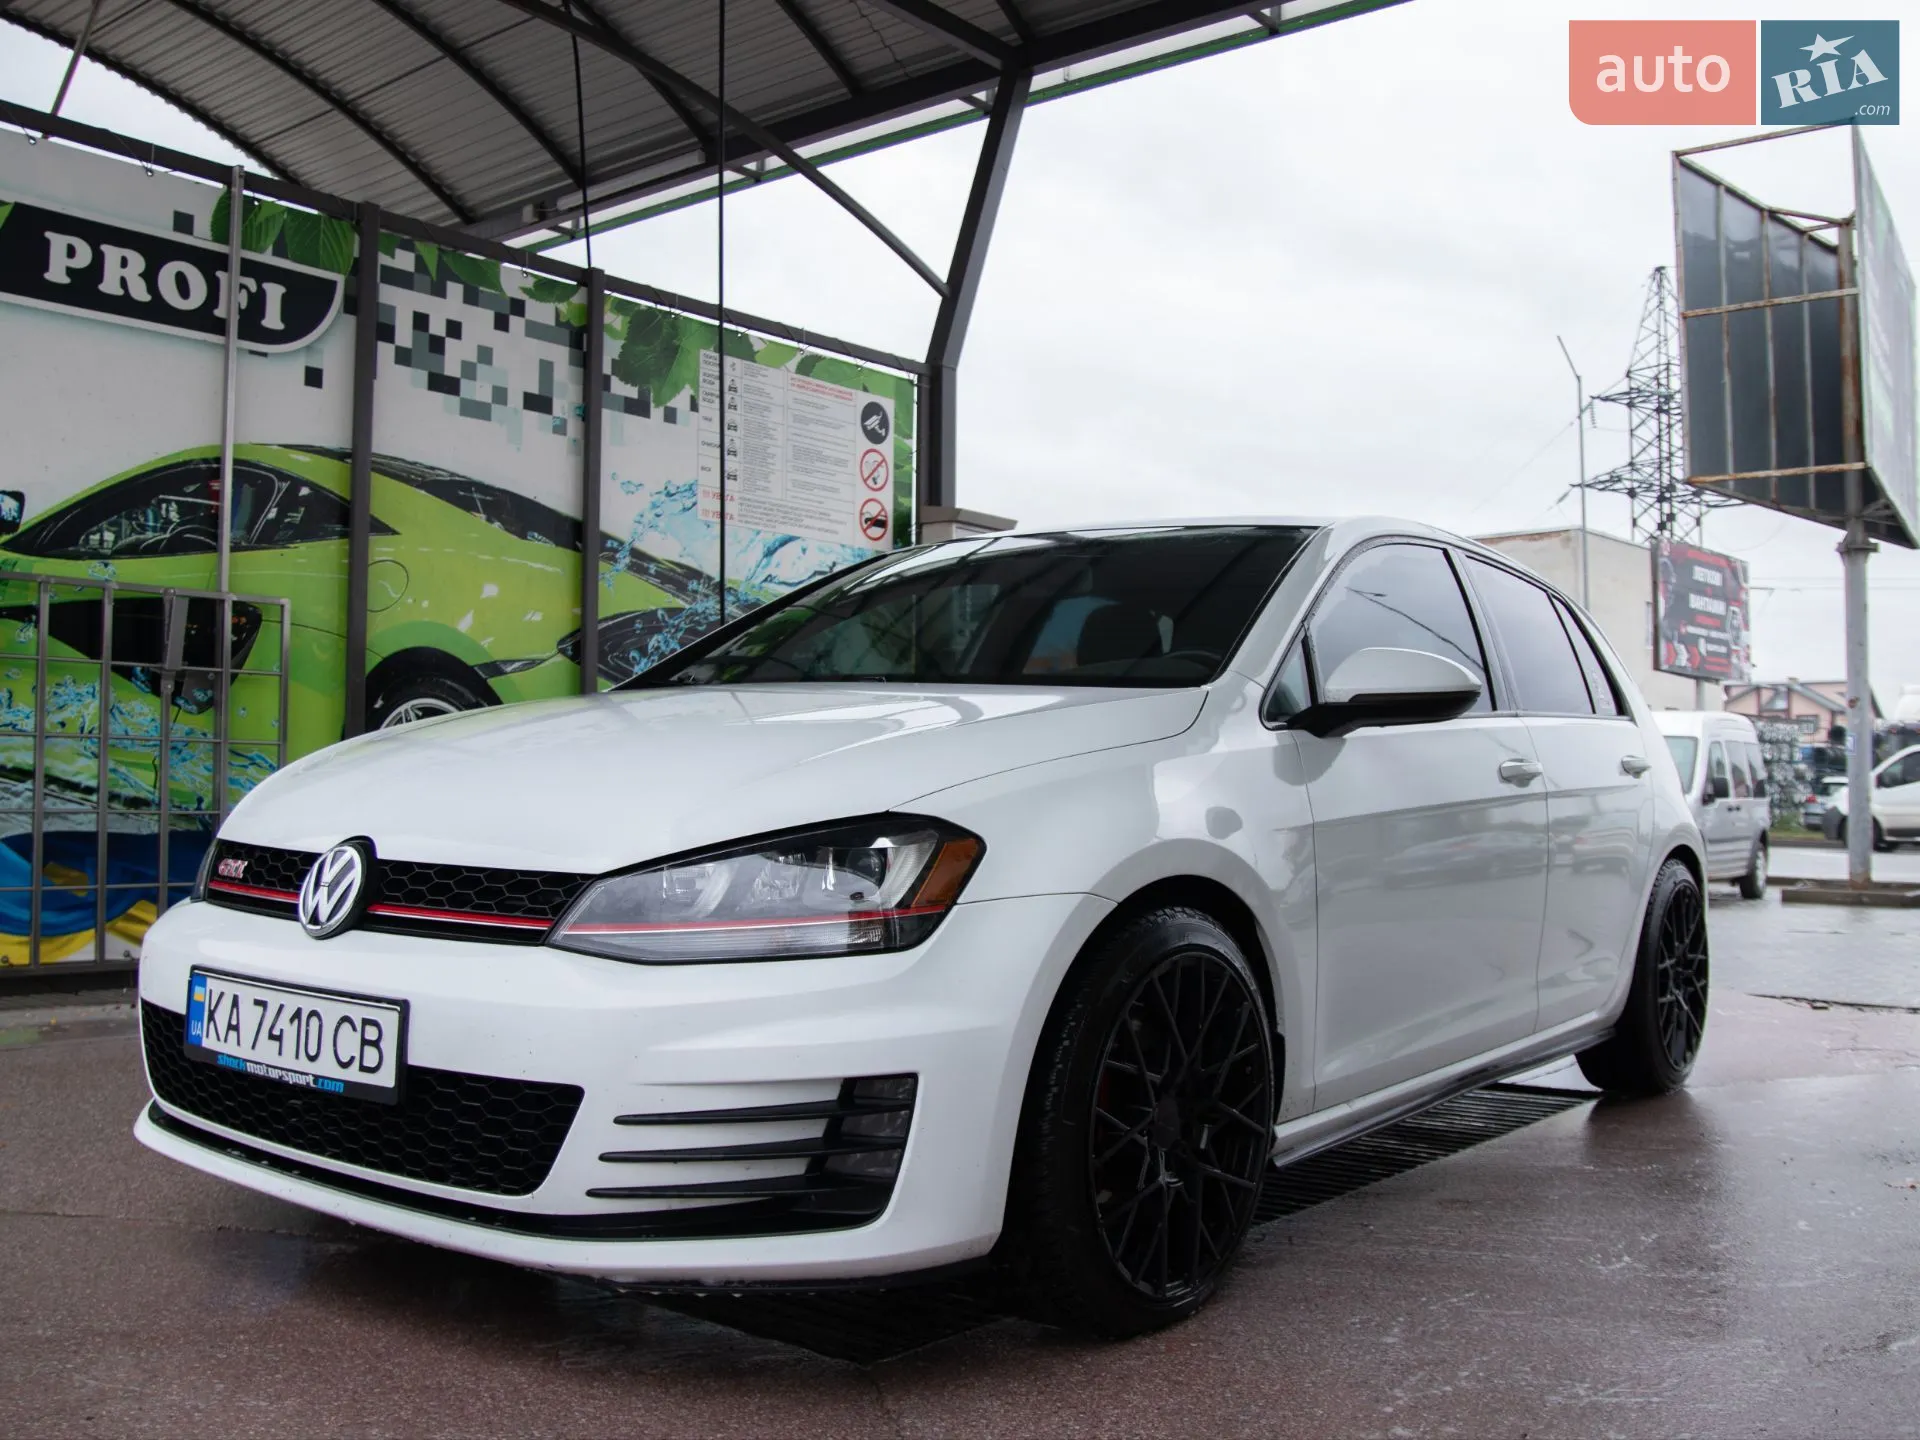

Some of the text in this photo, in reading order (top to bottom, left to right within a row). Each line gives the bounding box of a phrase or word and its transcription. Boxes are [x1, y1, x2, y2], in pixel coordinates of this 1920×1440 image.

[44, 231, 287, 330] PROFI
[218, 858, 249, 879] GTI
[191, 1019, 202, 1037] UA
[206, 988, 385, 1075] KA 7410 CB
[217, 1053, 345, 1094] shockmotorsport.com
